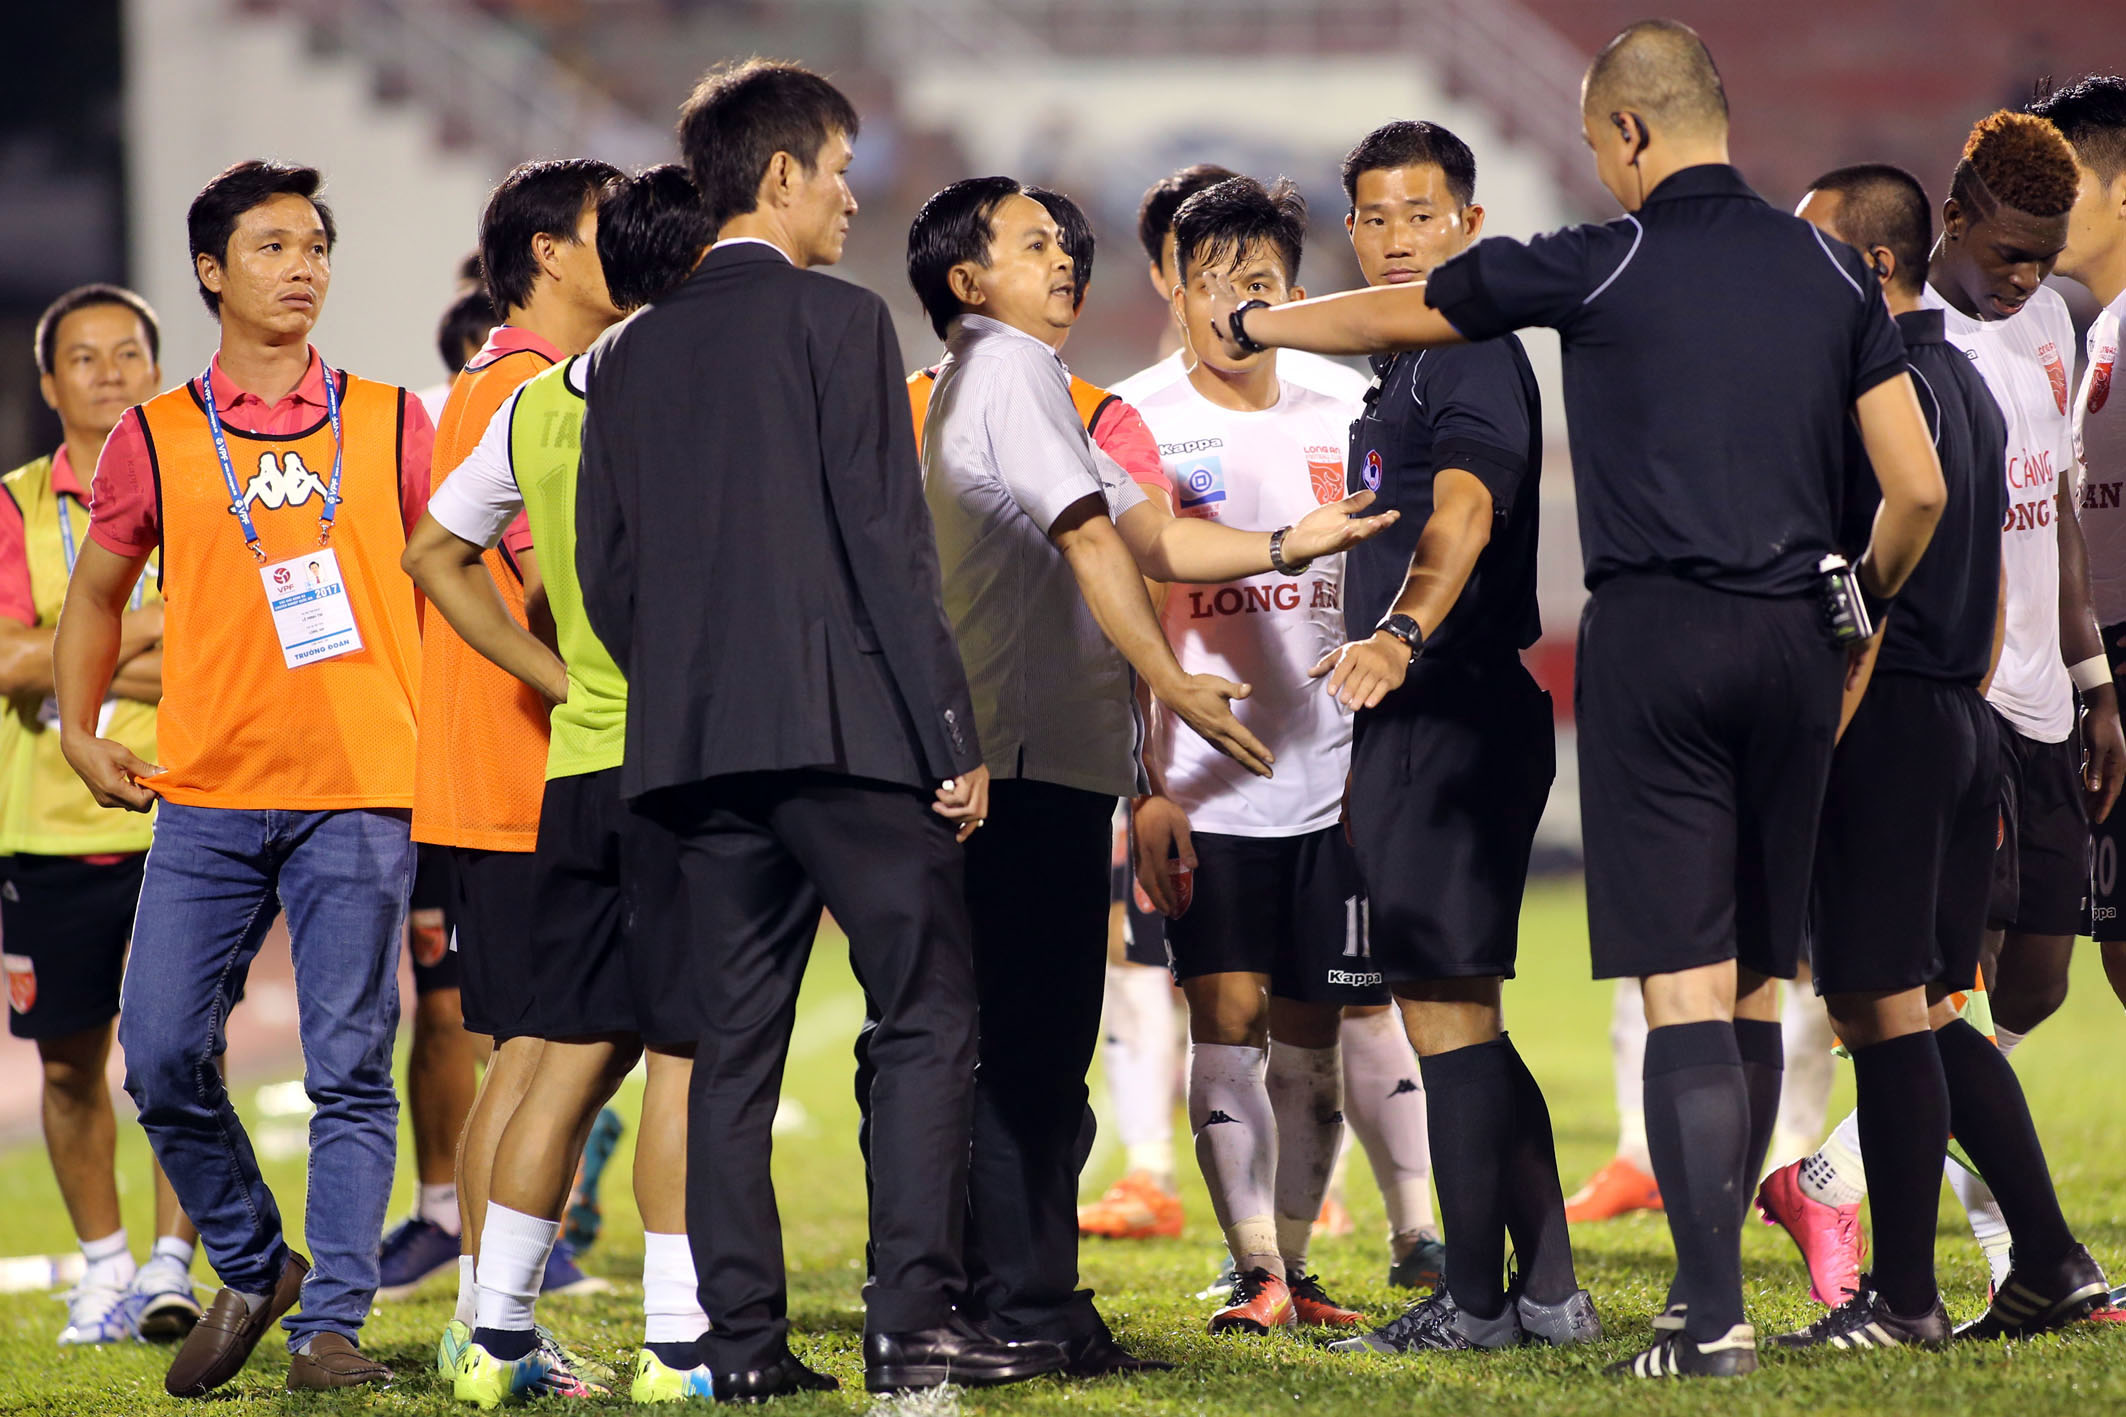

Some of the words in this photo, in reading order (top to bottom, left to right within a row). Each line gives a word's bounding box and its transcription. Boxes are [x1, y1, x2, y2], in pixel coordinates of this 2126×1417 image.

[218, 444, 229, 461] VPF
[1158, 438, 1224, 456] Kappa
[329, 478, 339, 496] VPF
[238, 507, 250, 526] VPF
[276, 583, 295, 594] VPF
[314, 583, 338, 600] 2017
[1188, 582, 1301, 619] LONG
[1309, 581, 1338, 608] AN
[1342, 894, 1371, 958] 11
[1327, 969, 1383, 986] Kappa
